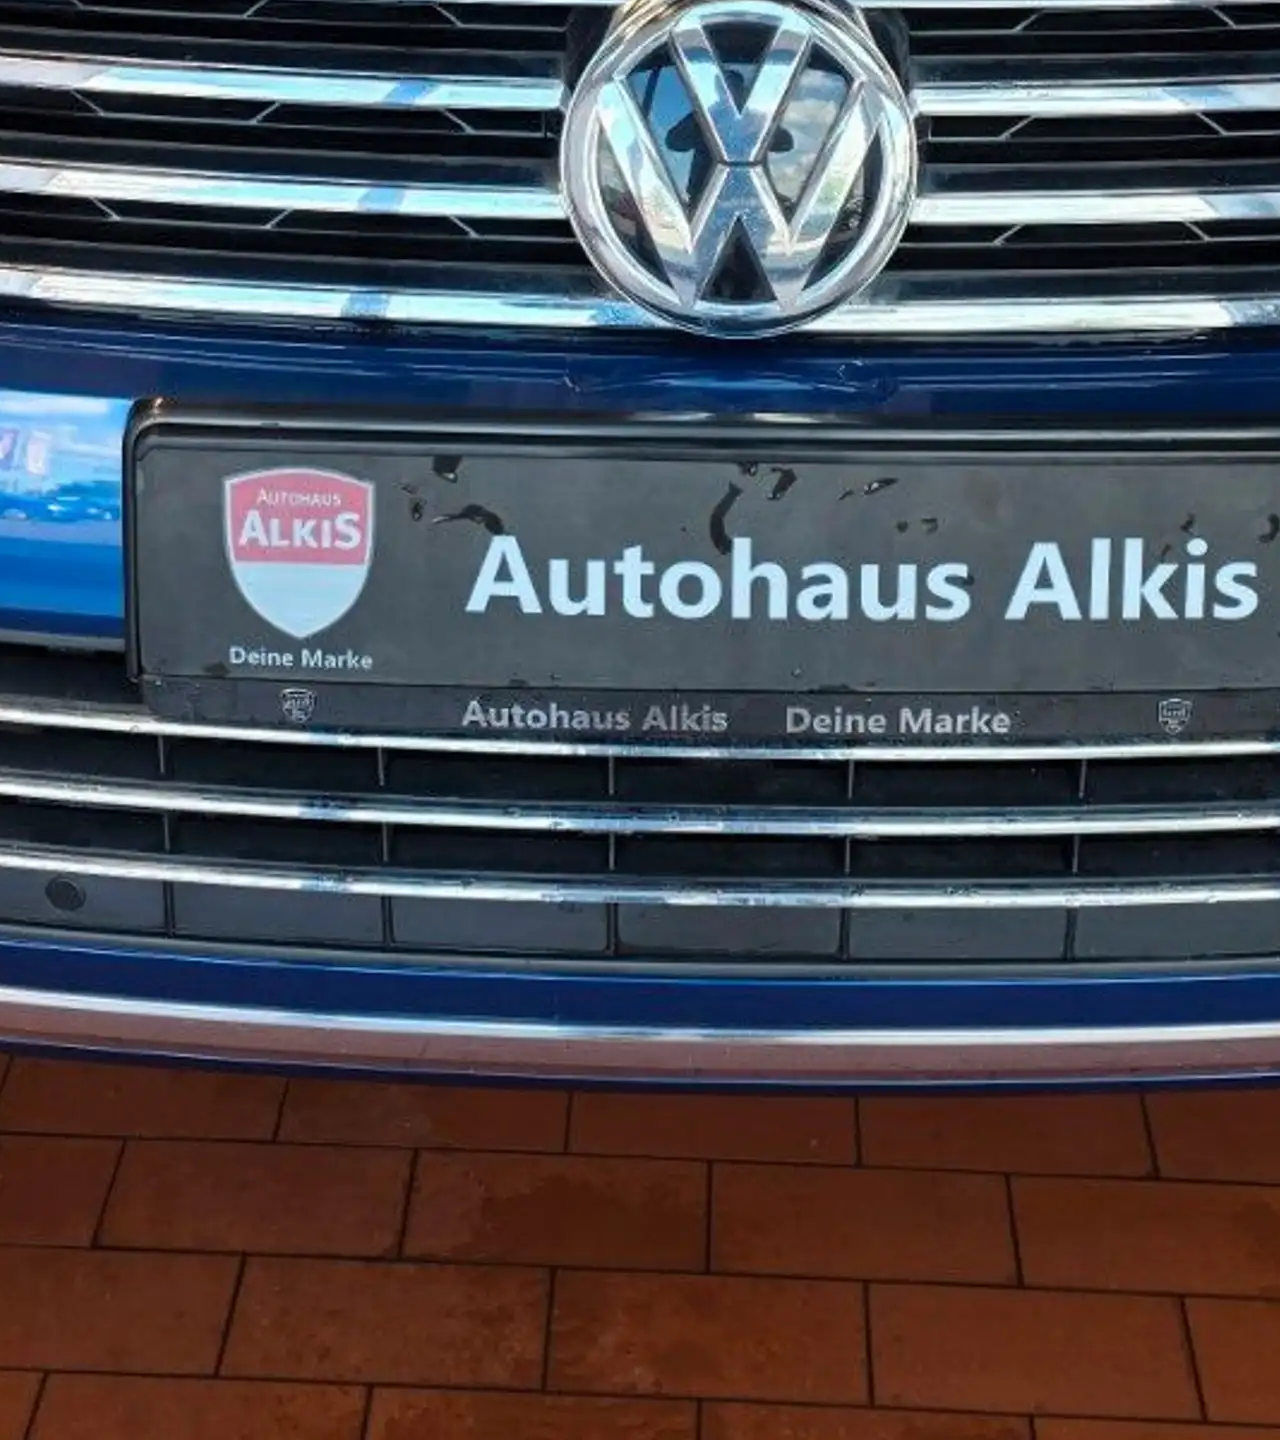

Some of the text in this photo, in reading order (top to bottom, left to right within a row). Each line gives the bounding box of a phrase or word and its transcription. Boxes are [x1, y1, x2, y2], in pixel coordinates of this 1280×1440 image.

[239, 509, 362, 550] ALKIS
[464, 534, 1260, 621] Autohaus Alkis
[229, 646, 373, 670] Deine Marke
[461, 700, 1012, 735] Autohaus Alkis Deine Marke
